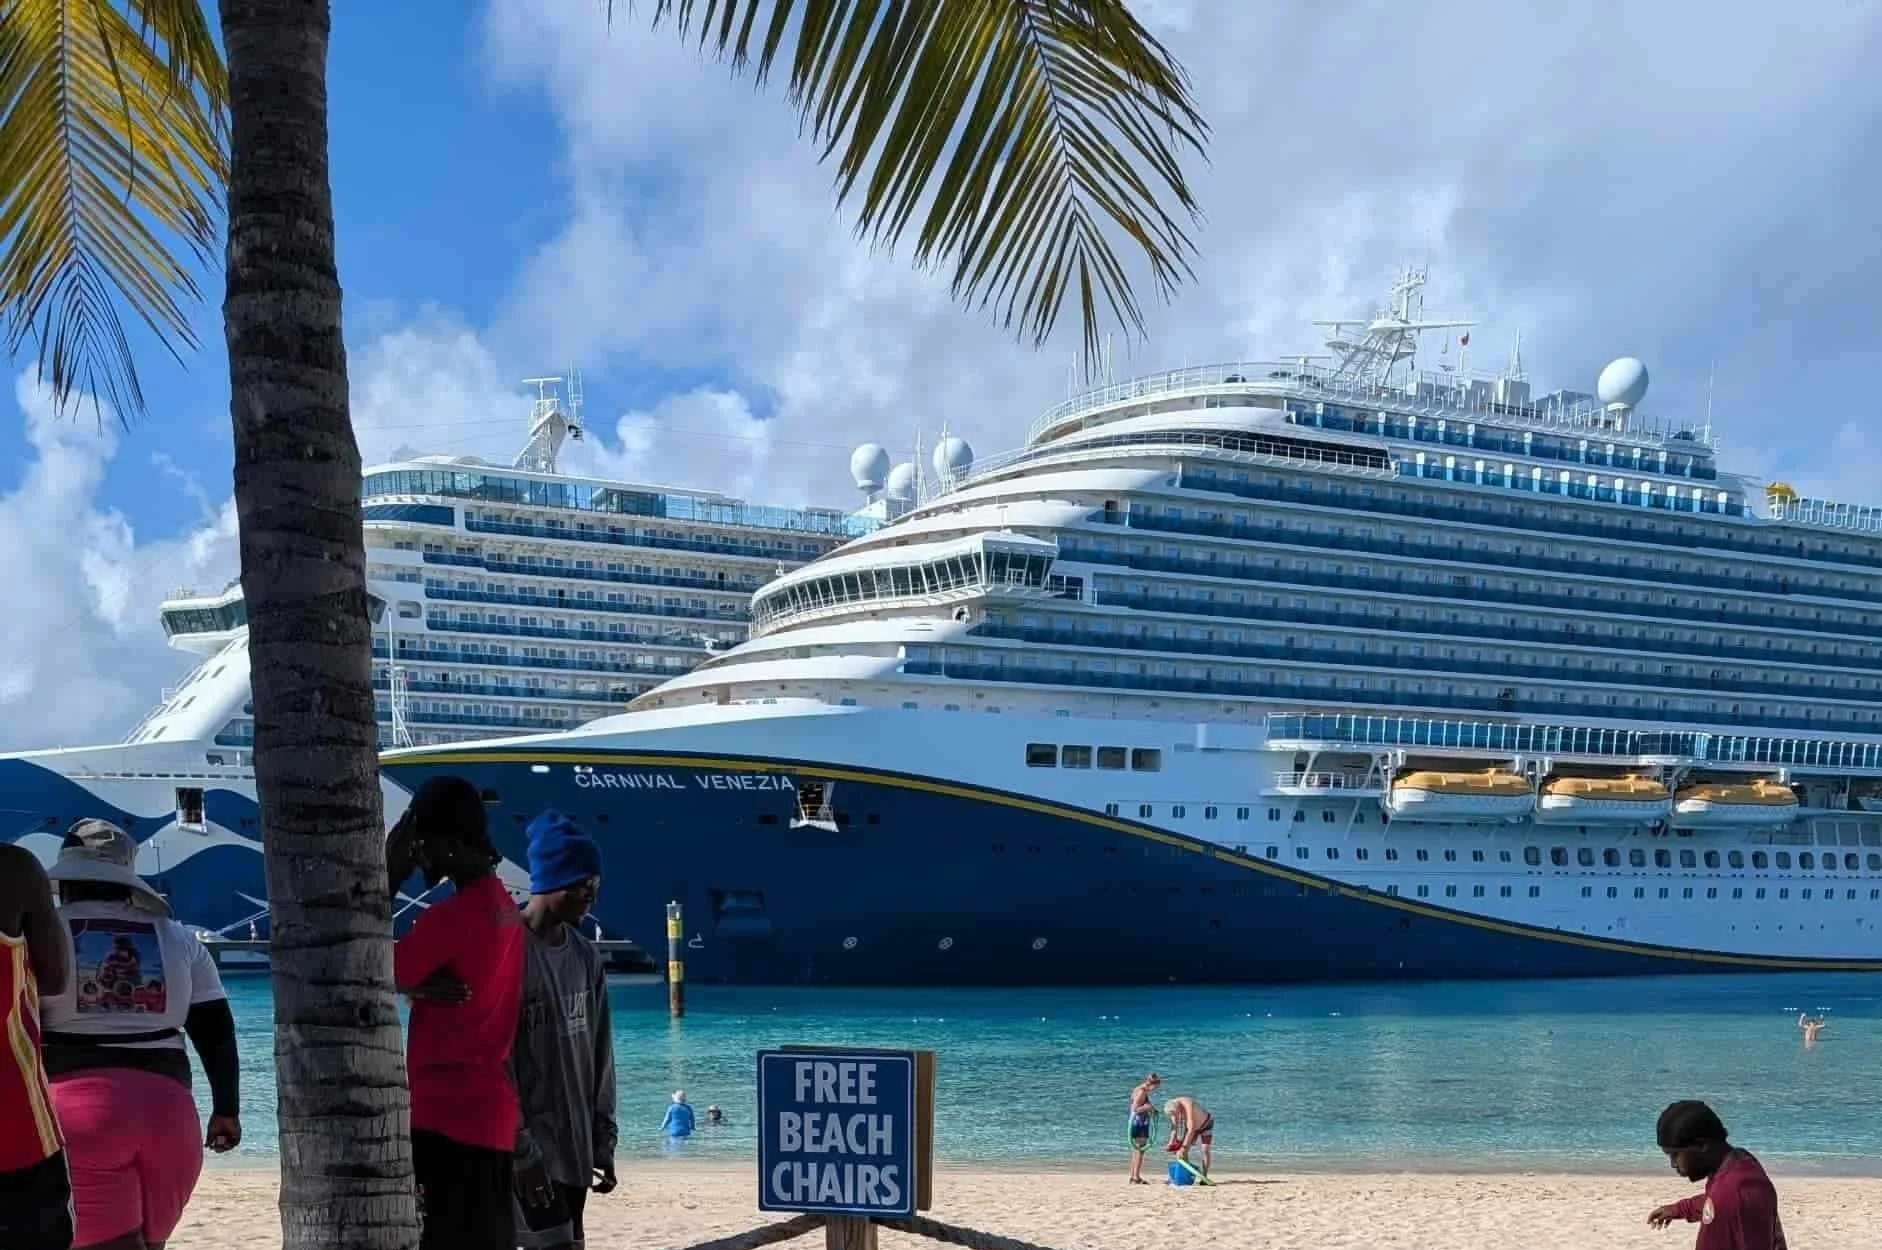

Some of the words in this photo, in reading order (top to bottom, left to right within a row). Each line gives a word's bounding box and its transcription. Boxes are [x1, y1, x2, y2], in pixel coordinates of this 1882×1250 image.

[574, 773, 686, 789] CARNIVAL
[695, 774, 795, 791] VENEZIA
[795, 1061, 877, 1105] FREE
[779, 1111, 893, 1156] BEACH
[772, 1161, 901, 1206] CHAIRS
